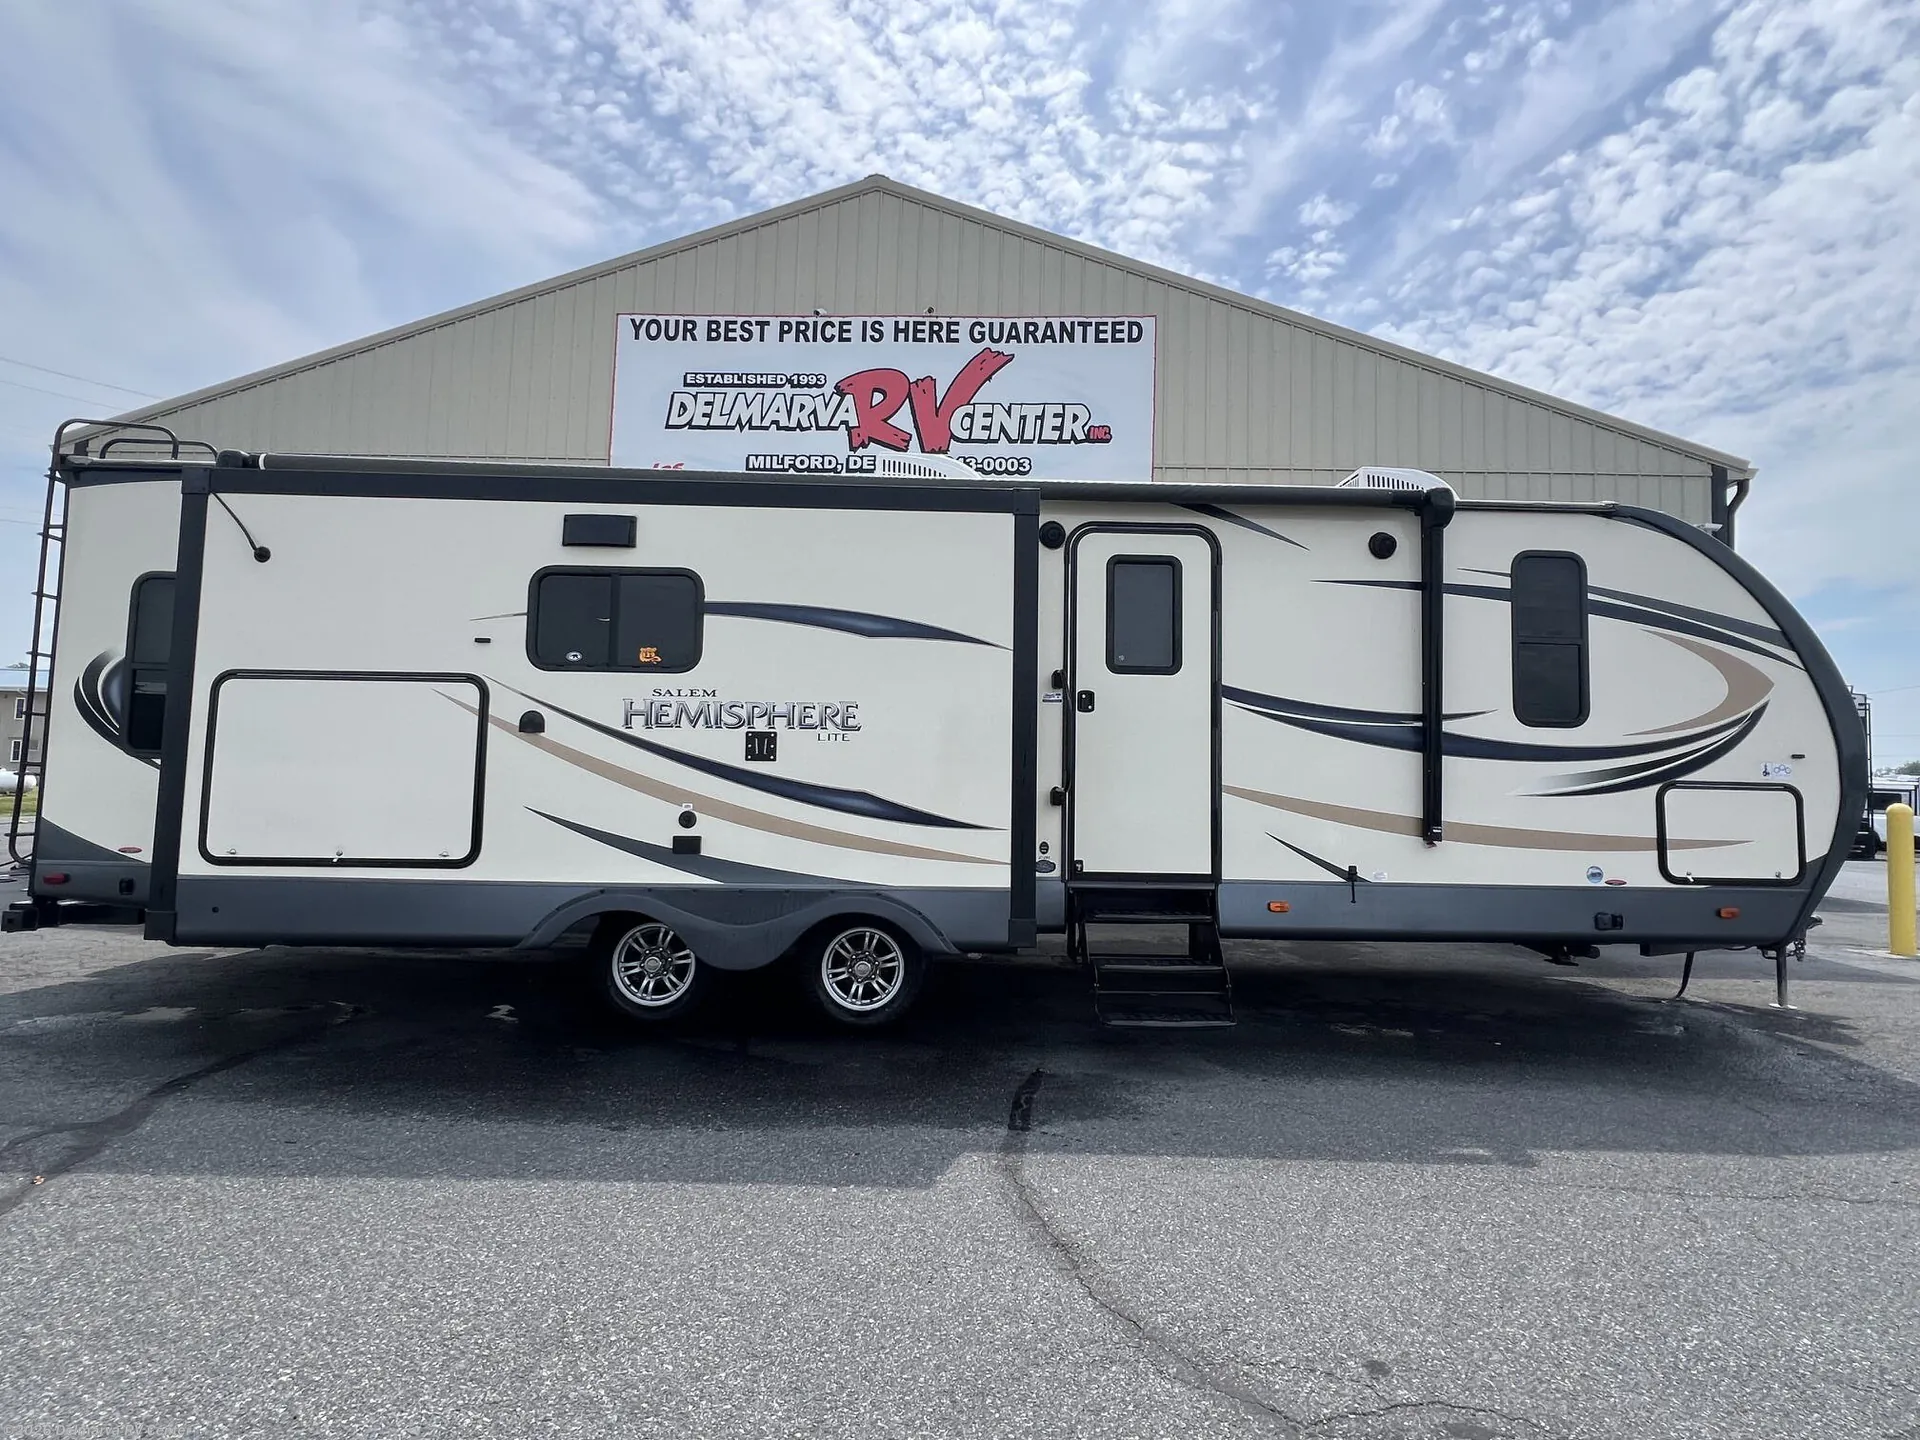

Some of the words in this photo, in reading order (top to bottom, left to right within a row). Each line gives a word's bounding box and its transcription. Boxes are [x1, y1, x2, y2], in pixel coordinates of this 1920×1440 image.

[630, 318, 698, 341] YOUR
[706, 320, 771, 342] BEST
[778, 320, 852, 343] PRICE
[861, 320, 885, 343] IS
[893, 320, 960, 343] HERE
[969, 321, 1144, 344] GUARANTEED
[685, 373, 787, 386] ESTABLISHED
[790, 374, 826, 386] 1993
[666, 392, 860, 431] DELMARVA
[835, 347, 1015, 453] RV
[950, 403, 1091, 444] CENTER
[747, 454, 843, 472] MILFORD,
[849, 454, 876, 472] DE
[957, 456, 1032, 474] 3-0003
[652, 688, 717, 698] SALEM
[622, 698, 862, 732] HEMISPHERE
[817, 732, 850, 742] LITE
